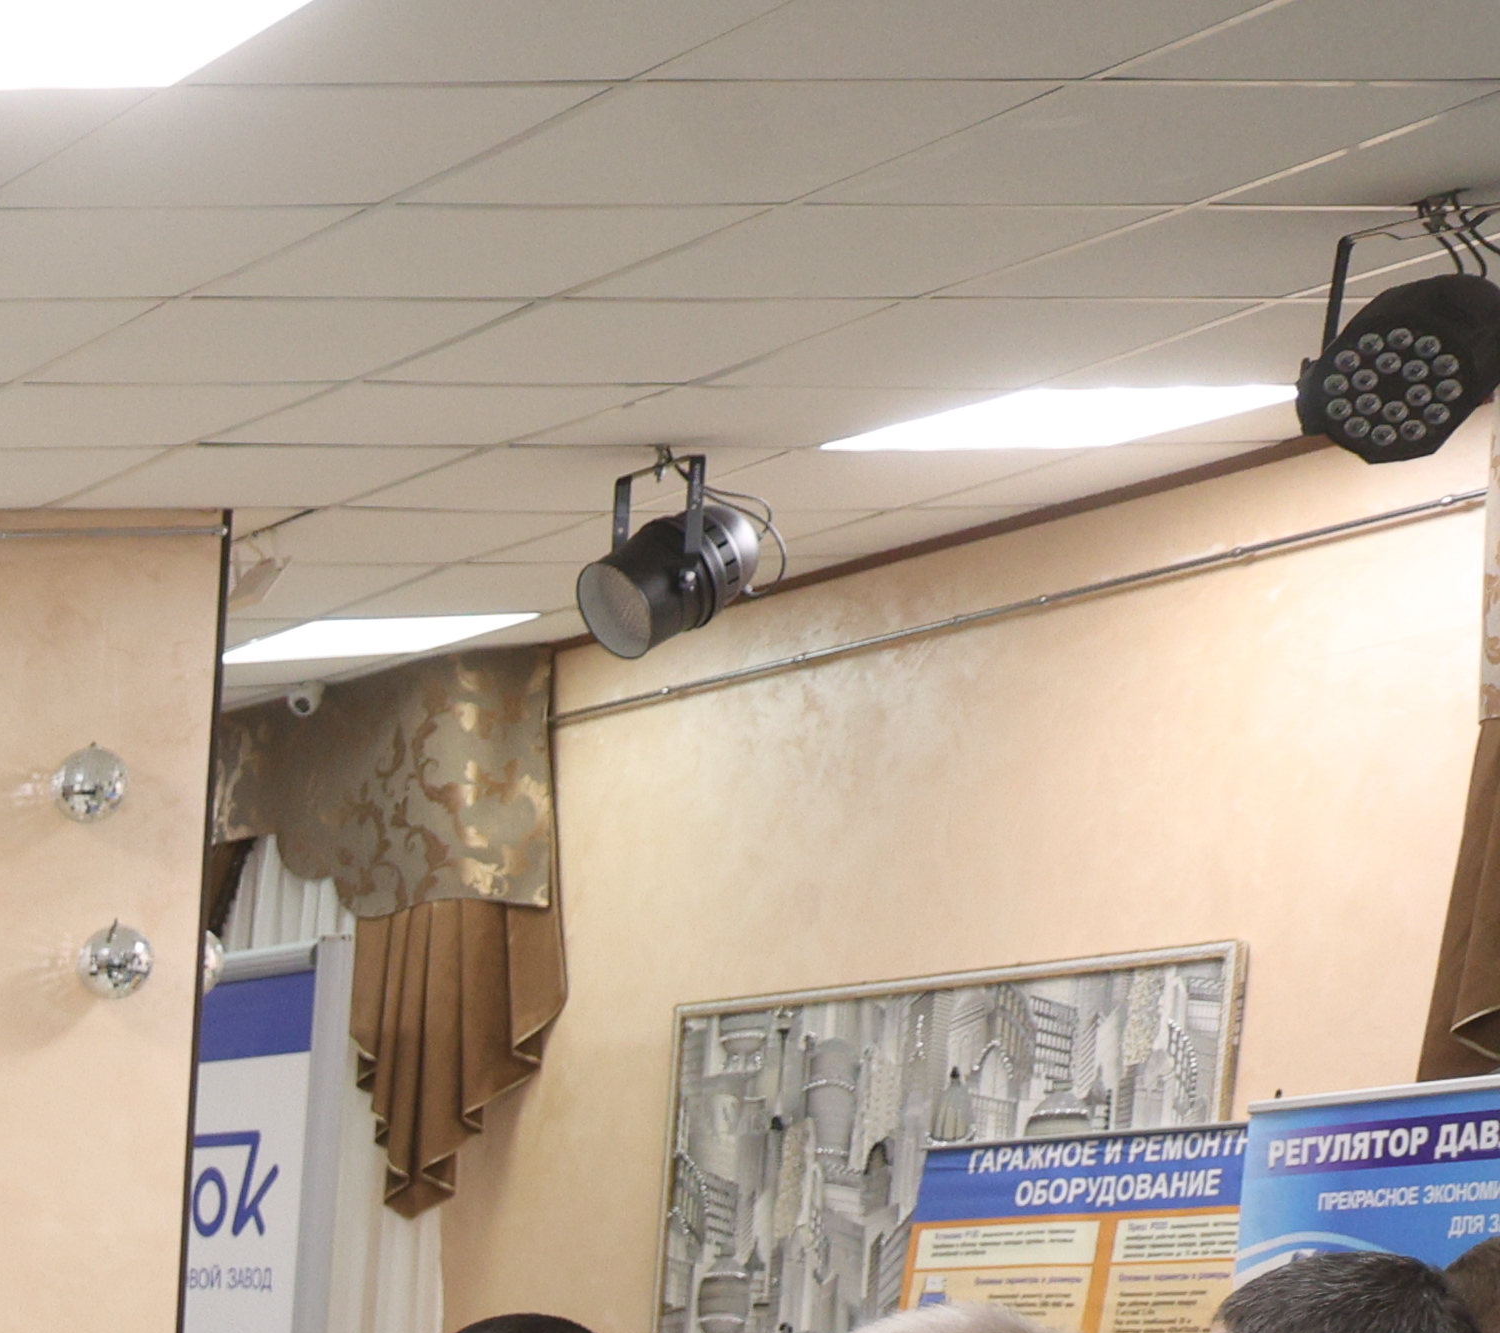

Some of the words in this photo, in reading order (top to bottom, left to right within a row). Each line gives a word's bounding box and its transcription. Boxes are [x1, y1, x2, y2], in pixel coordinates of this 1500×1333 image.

[968, 1140, 1097, 1175] ГАРАЖНОЕ
[1104, 1139, 1122, 1164] И
[1267, 1126, 1429, 1169] РЕГУЛЯТОР
[1434, 1119, 1500, 1160] ДАВ
[1014, 1169, 1222, 1207] ОБОРУДОВАНИЕ
[1317, 1185, 1420, 1212] ПРЕКРАСНОЕ
[1448, 1213, 1484, 1239] ДЛЯ
[227, 1267, 273, 1293] ЗАВОД
